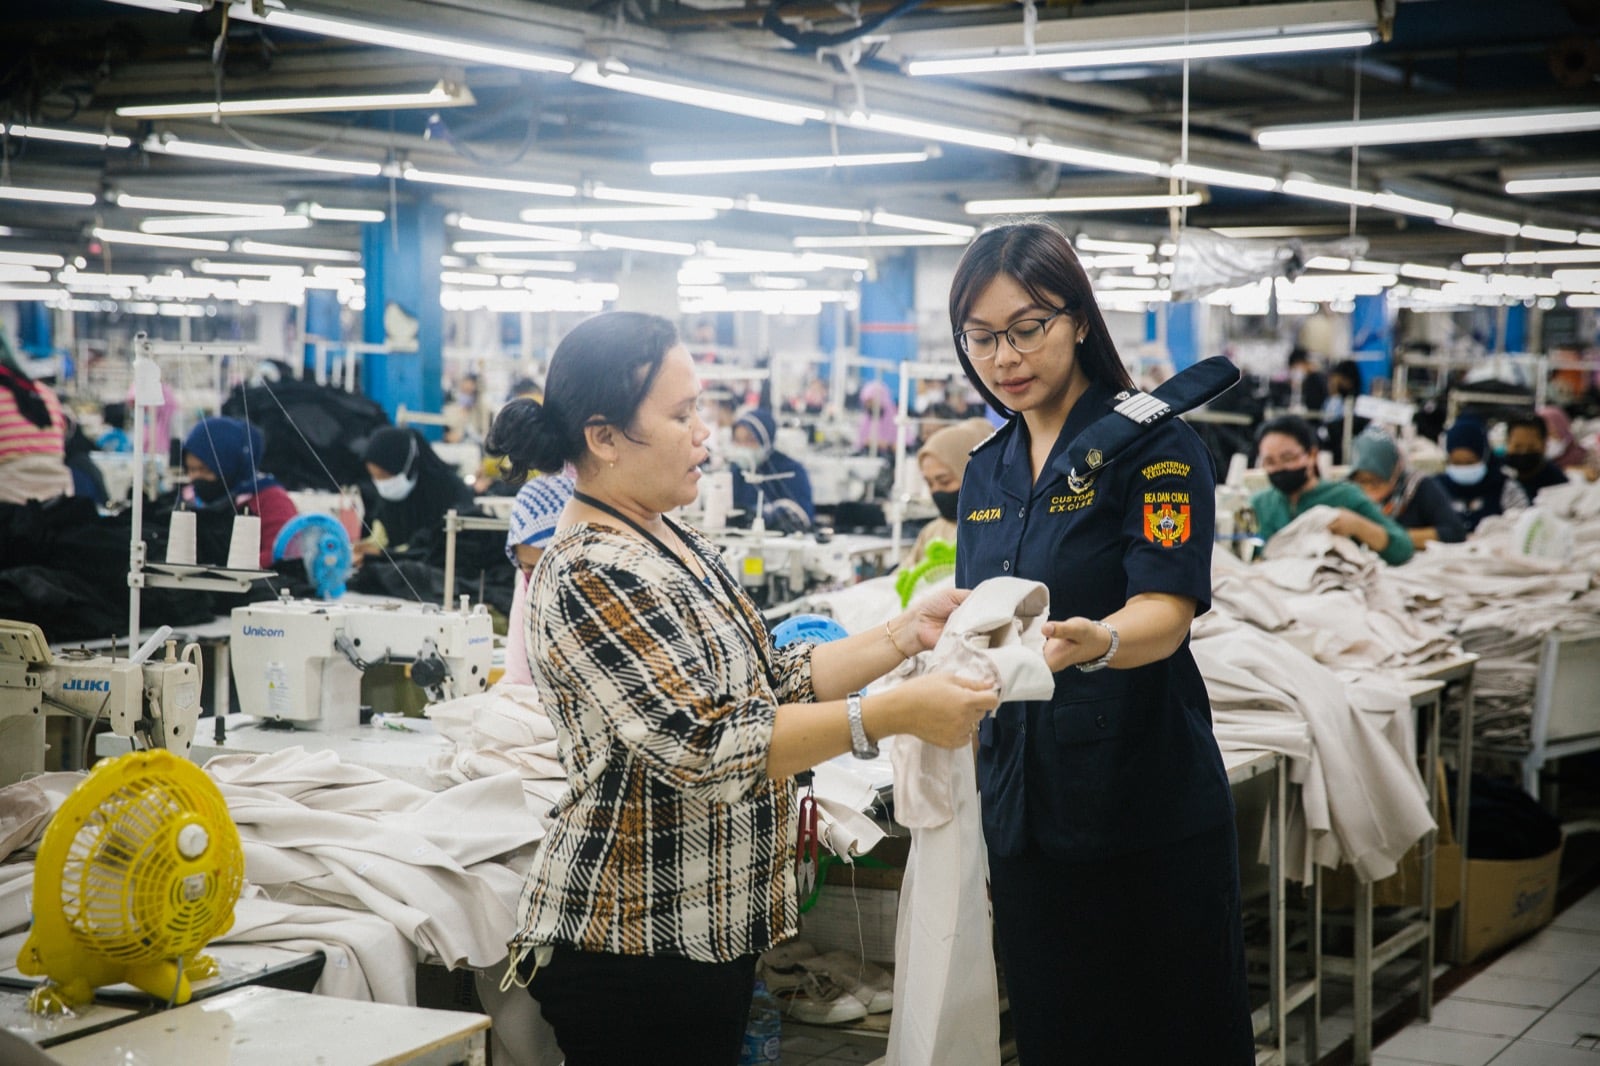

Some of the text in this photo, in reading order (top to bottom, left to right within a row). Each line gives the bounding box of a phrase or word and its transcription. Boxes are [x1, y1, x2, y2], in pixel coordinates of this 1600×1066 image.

[1141, 461, 1191, 476] KEMENTERIAN
[1146, 468, 1188, 480] KEUANGAN
[1051, 489, 1096, 504] CUSTOMS
[1144, 492, 1190, 504] BEA DAN CUKAI
[1049, 497, 1093, 513] EXCISE
[967, 508, 1001, 521] AGATA
[243, 625, 285, 637] Unicorn
[63, 679, 110, 692] JUKI
